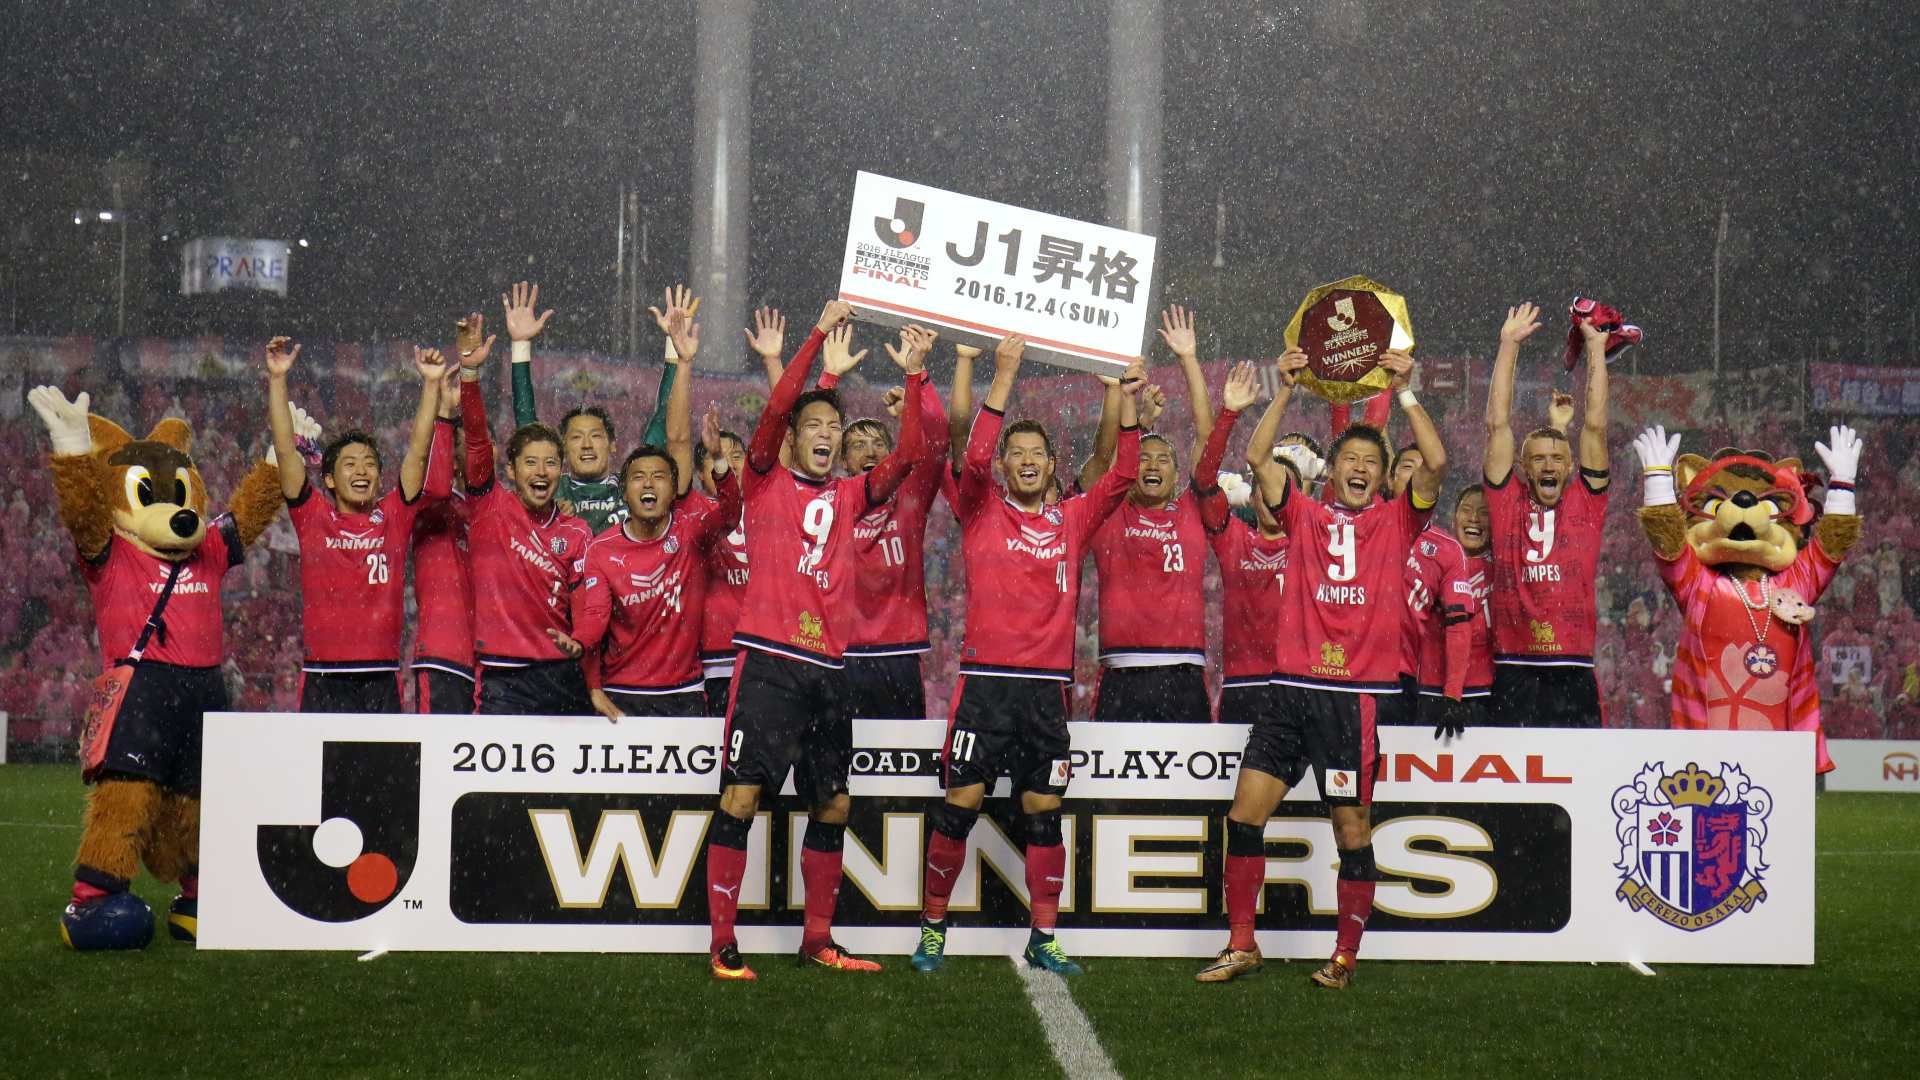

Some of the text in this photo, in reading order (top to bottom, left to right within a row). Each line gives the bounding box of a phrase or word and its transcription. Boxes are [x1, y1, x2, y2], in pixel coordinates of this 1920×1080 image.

[857, 242, 881, 254] 2016
[944, 220, 1140, 304] J1昇格
[852, 265, 927, 290] FINAL
[1322, 342, 1377, 365] WINNERS
[803, 499, 835, 567] 9
[510, 537, 561, 578] YANMA
[879, 537, 905, 567] 10
[1163, 544, 1184, 573] 23
[1327, 524, 1356, 582] 9
[366, 553, 389, 586] 26
[790, 635, 827, 652] SINGHA
[1311, 665, 1351, 677] SINGHA
[453, 742, 725, 774] 2016 J.LEAG
[731, 730, 744, 762] 9
[952, 730, 977, 762] 41
[852, 751, 920, 772] OAD
[1071, 750, 1241, 780] PLAY-OF
[1376, 754, 1573, 784] INAL
[1883, 762, 1920, 781] NH
[528, 808, 1499, 919] WINNERS
[404, 900, 423, 910] TM
[1640, 891, 1744, 928] CEREZO OSAKA
